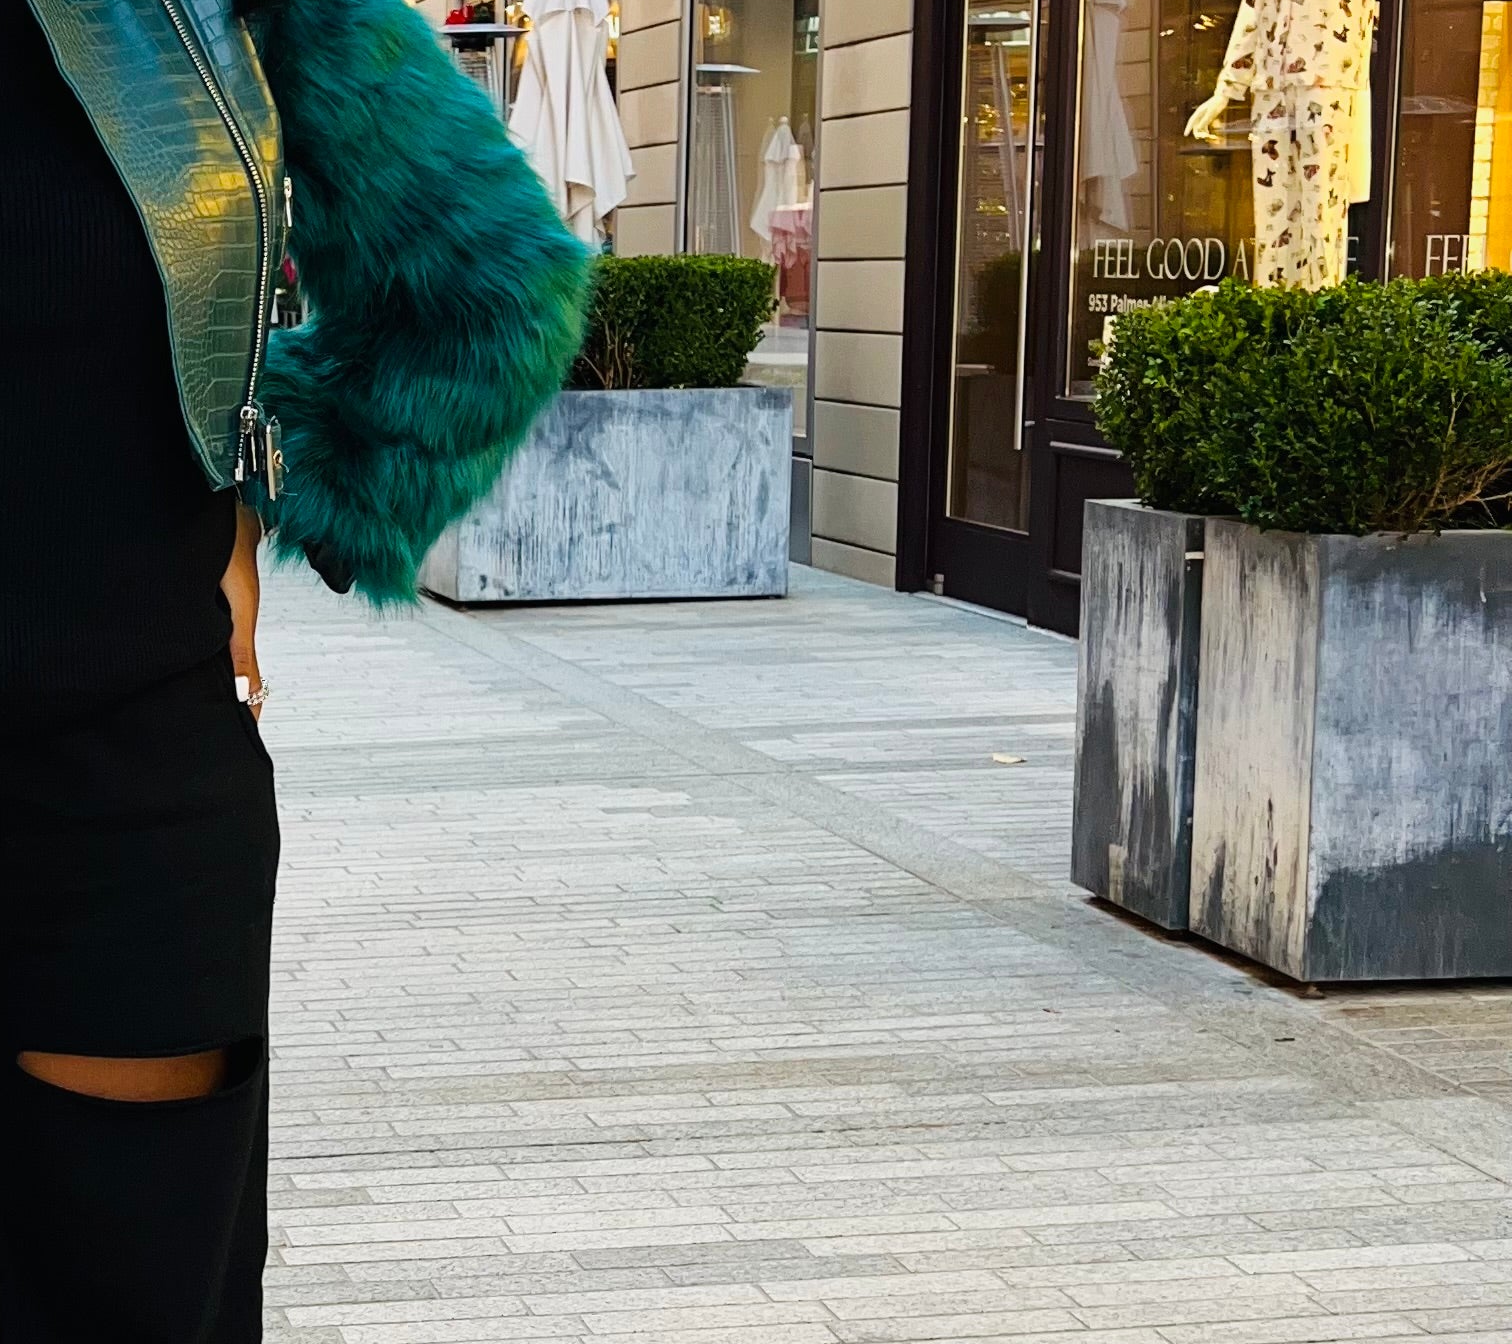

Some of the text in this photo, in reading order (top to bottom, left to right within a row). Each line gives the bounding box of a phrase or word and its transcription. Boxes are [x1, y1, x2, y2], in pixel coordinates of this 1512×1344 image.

[1093, 237, 1140, 279] FEEL
[1146, 237, 1226, 281] GOOD
[1088, 293, 1109, 313] 953
